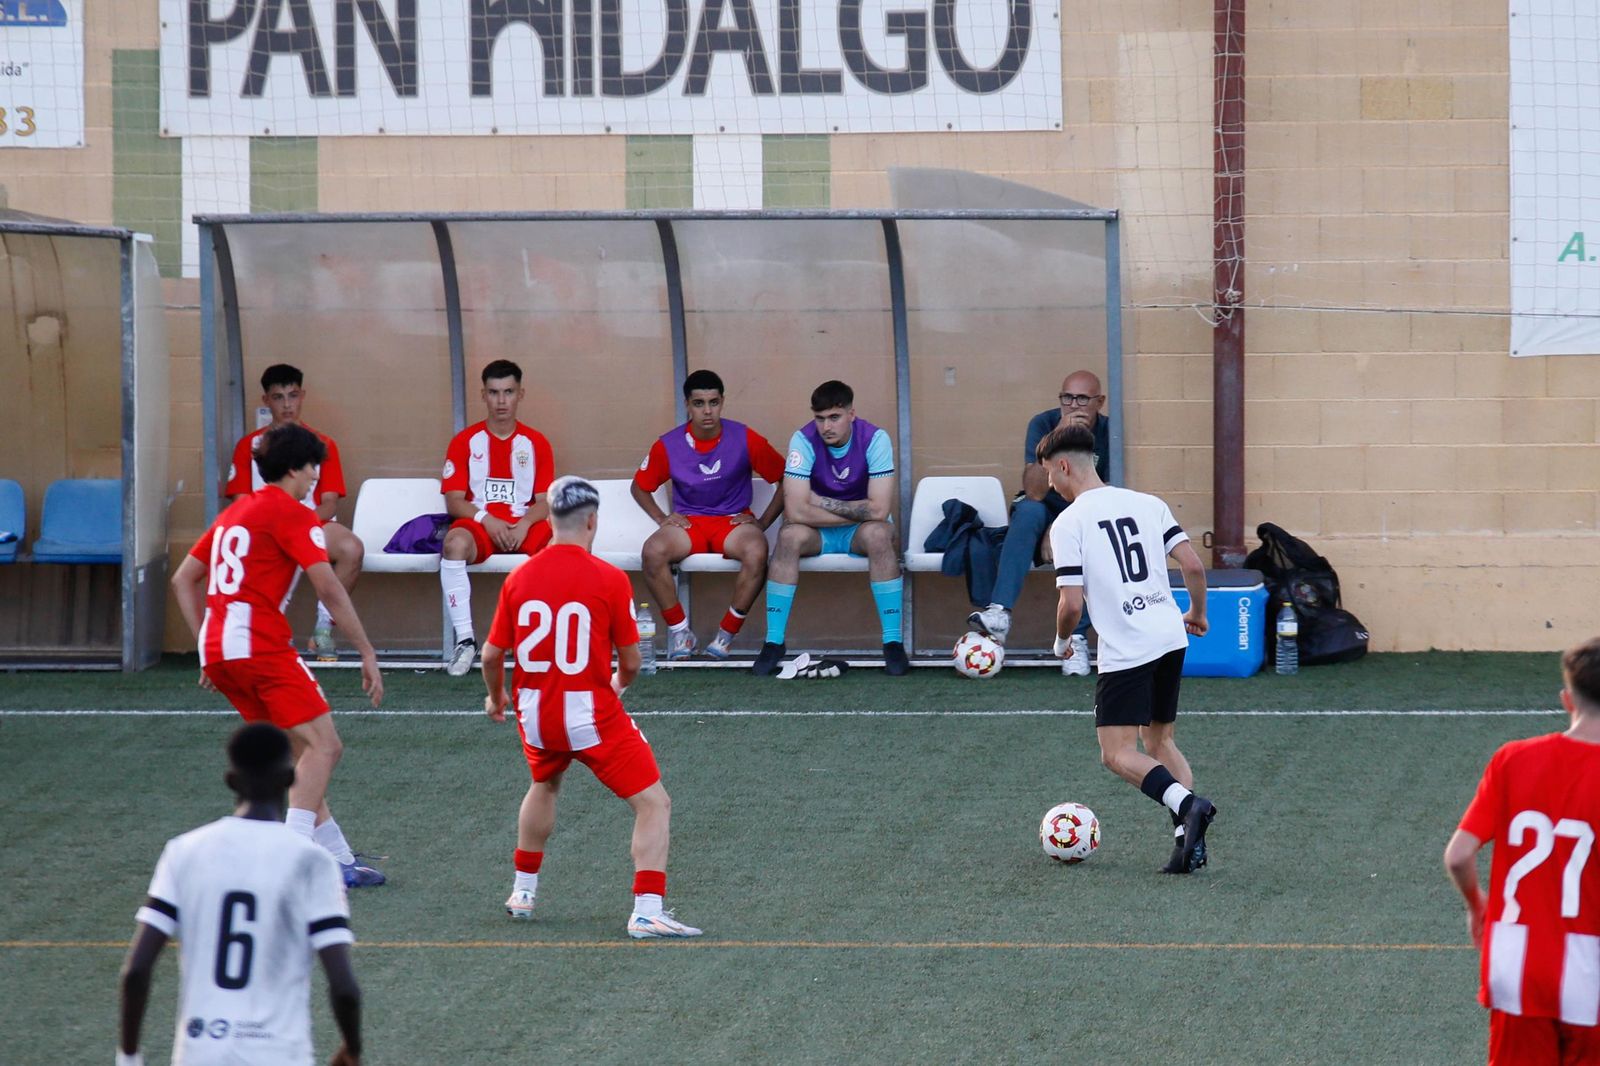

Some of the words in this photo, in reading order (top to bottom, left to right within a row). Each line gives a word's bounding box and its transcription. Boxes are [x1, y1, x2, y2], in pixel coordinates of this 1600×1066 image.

[188, 0, 419, 98] PAN
[469, 0, 1033, 97] HIDALGO
[1557, 231, 1597, 262] A.
[207, 525, 251, 596] 18
[1098, 516, 1149, 584] 16
[516, 599, 592, 676] 20
[1238, 596, 1251, 650] Coleman
[1500, 809, 1596, 923] 27
[214, 889, 257, 990] 6
